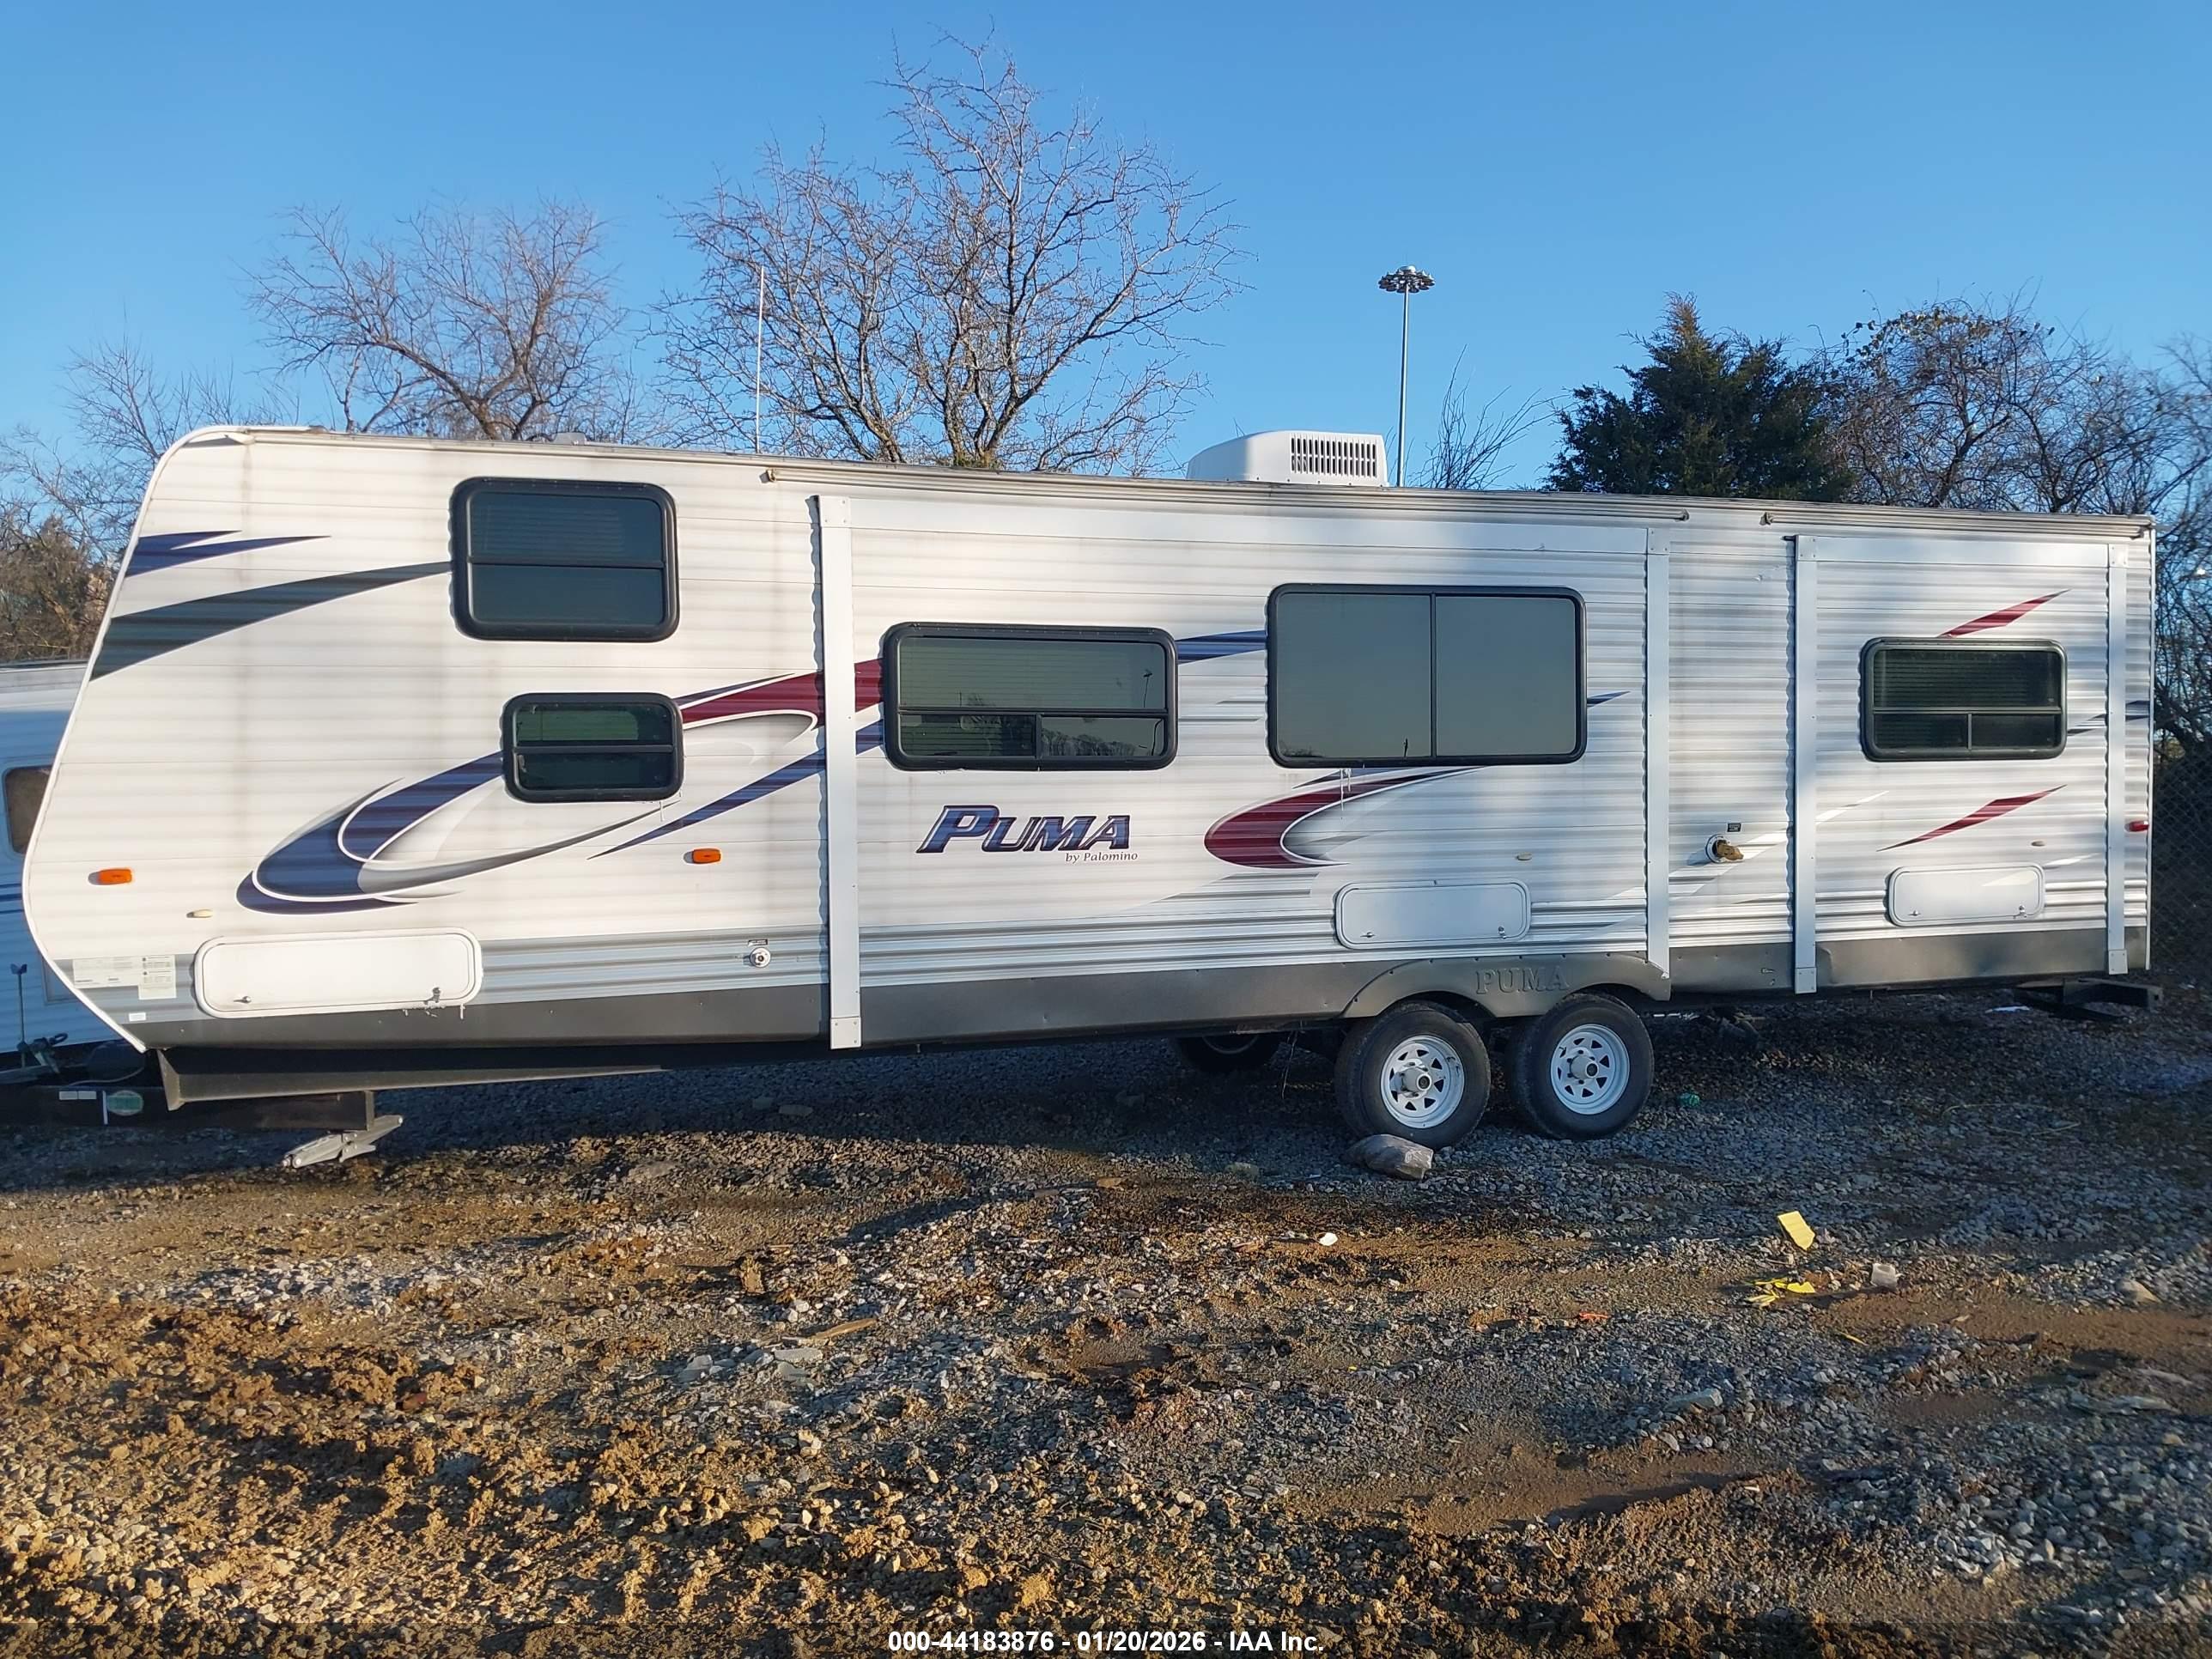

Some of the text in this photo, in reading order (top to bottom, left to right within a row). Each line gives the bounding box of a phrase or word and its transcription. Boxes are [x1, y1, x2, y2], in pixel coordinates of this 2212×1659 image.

[915, 804, 1131, 854] PUMA
[1065, 850, 1139, 864] by Palomino
[1475, 965, 1570, 995] PUMA
